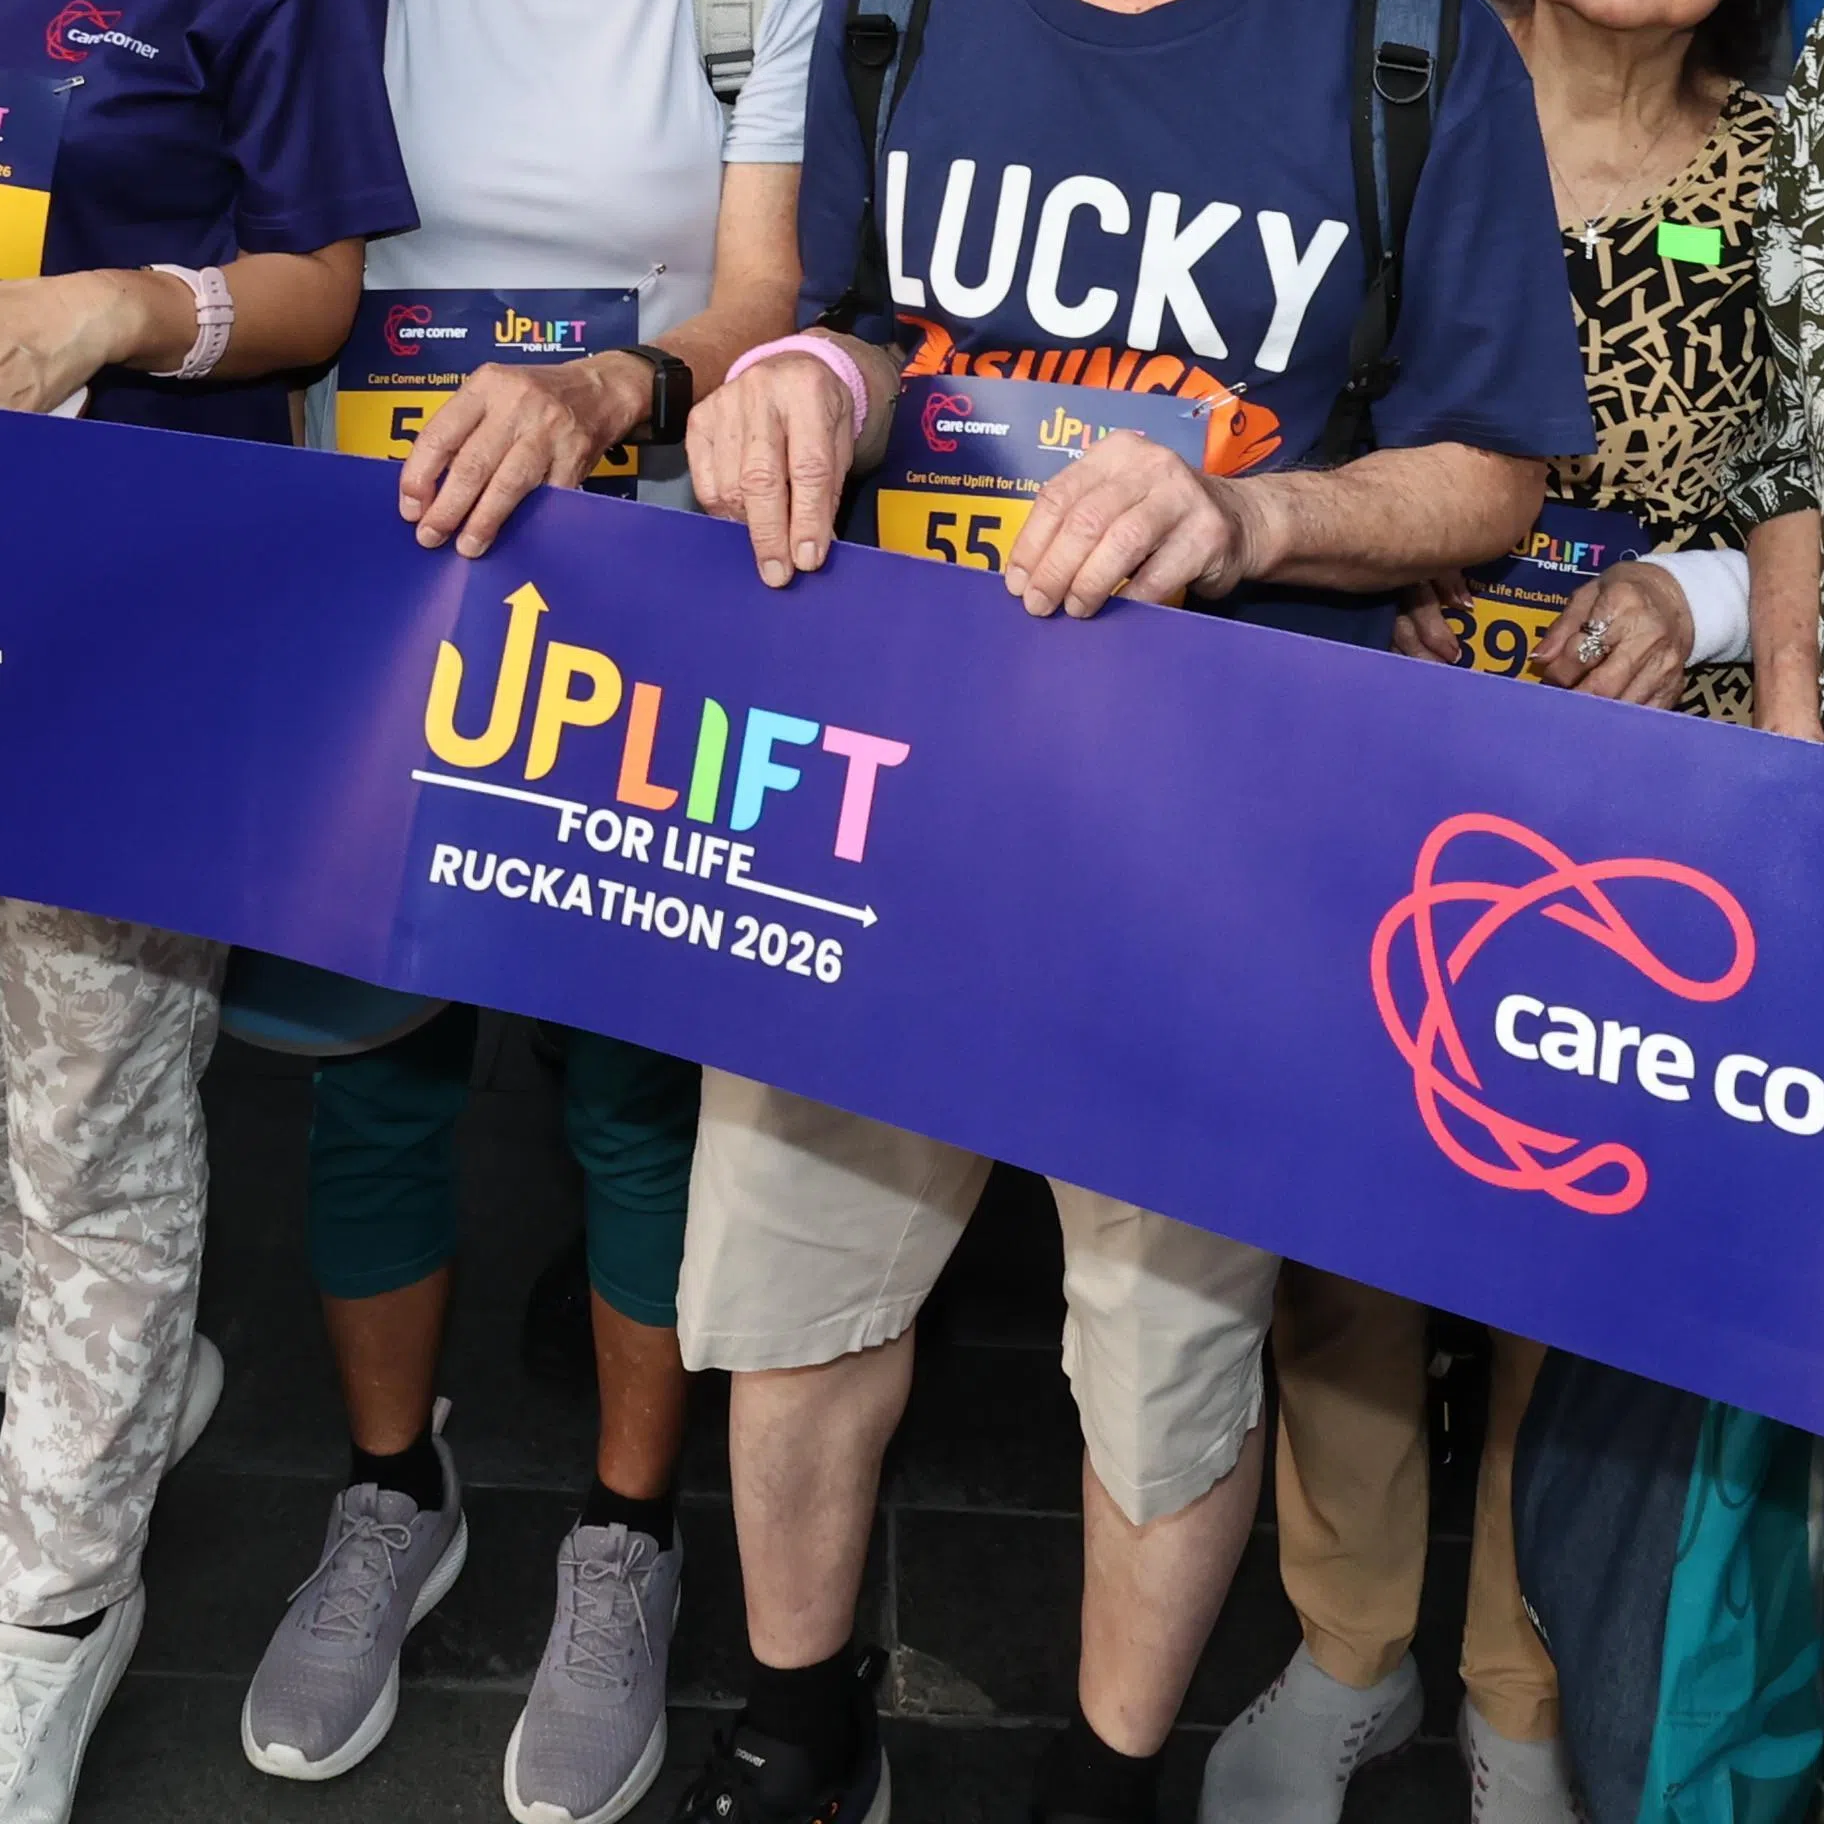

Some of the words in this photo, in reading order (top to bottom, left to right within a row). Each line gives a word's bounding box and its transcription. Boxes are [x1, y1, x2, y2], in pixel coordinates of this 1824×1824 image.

[103, 30, 160, 59] corner
[885, 150, 1350, 373] LUCKY
[399, 327, 425, 338] care
[426, 327, 468, 339] corner
[495, 308, 587, 344] UPLIFT
[522, 343, 542, 352] FOR
[543, 343, 562, 352] LIFE
[368, 374, 389, 384] Care
[391, 373, 426, 384] Corner
[427, 373, 459, 386] Uplift
[936, 419, 965, 433] care
[965, 420, 1010, 436] corner
[928, 472, 961, 486] Corner
[963, 474, 995, 489] Uplift
[996, 476, 1014, 490] for
[1016, 478, 1040, 492] Life
[1537, 560, 1557, 571] FOR
[1559, 563, 1578, 574] LIFE
[1489, 583, 1512, 597] Life
[424, 581, 911, 863] UPLIFT
[557, 803, 655, 864] FOR
[661, 825, 754, 885] LIFE
[428, 843, 725, 951] RUCKATHON
[729, 914, 844, 984] 2026
[1494, 993, 1696, 1102] care
